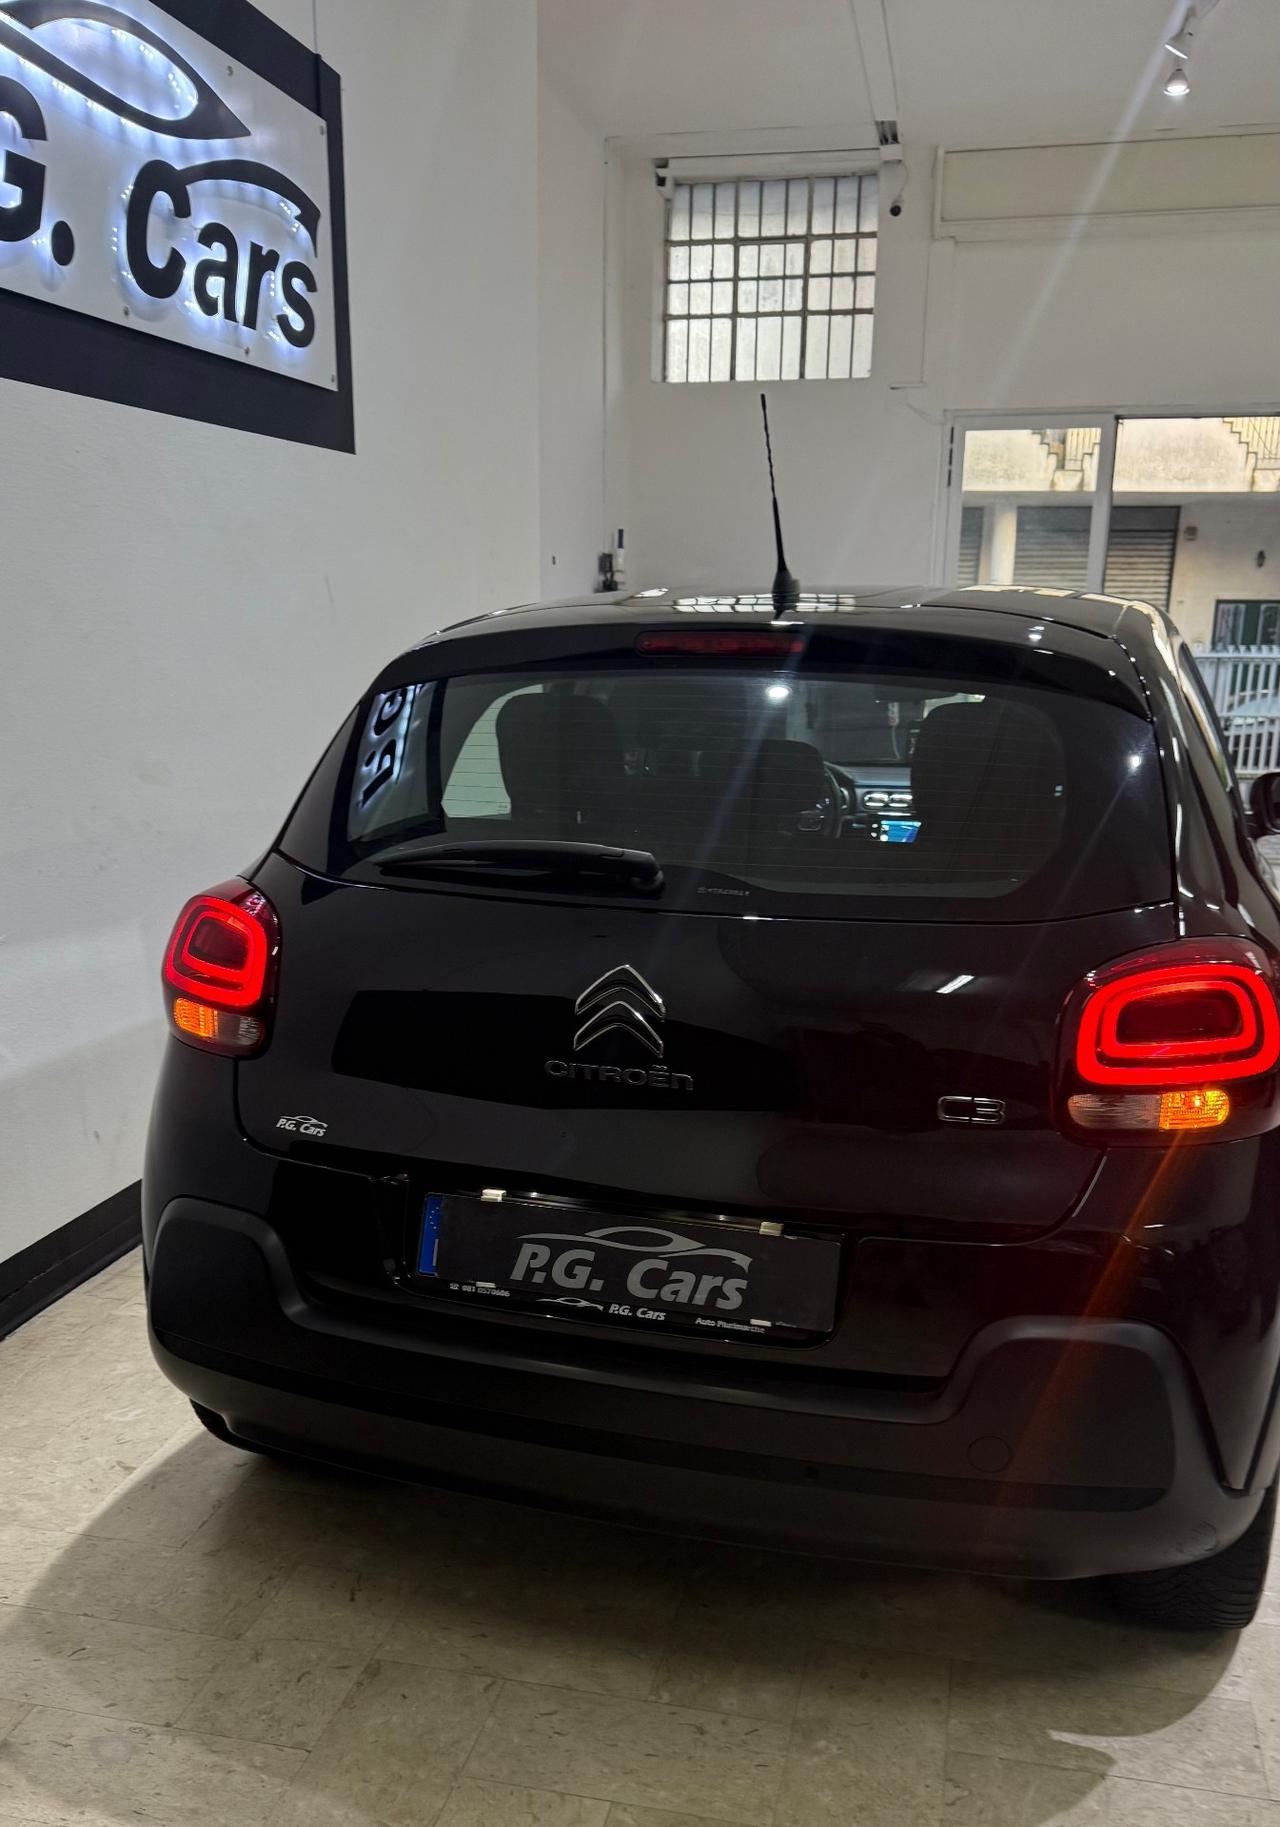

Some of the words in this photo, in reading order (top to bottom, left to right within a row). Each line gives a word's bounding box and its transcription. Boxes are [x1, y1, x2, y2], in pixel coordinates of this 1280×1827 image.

[127, 159, 319, 348] Cars
[544, 1060, 693, 1090] CITROËN
[937, 1096, 1006, 1125] C3
[275, 1118, 297, 1132] P.G.
[299, 1123, 327, 1137] Cars
[509, 1242, 605, 1292] P.G.
[626, 1257, 749, 1311] Cars
[608, 1303, 633, 1316] P.G.
[636, 1307, 667, 1321] Cars
